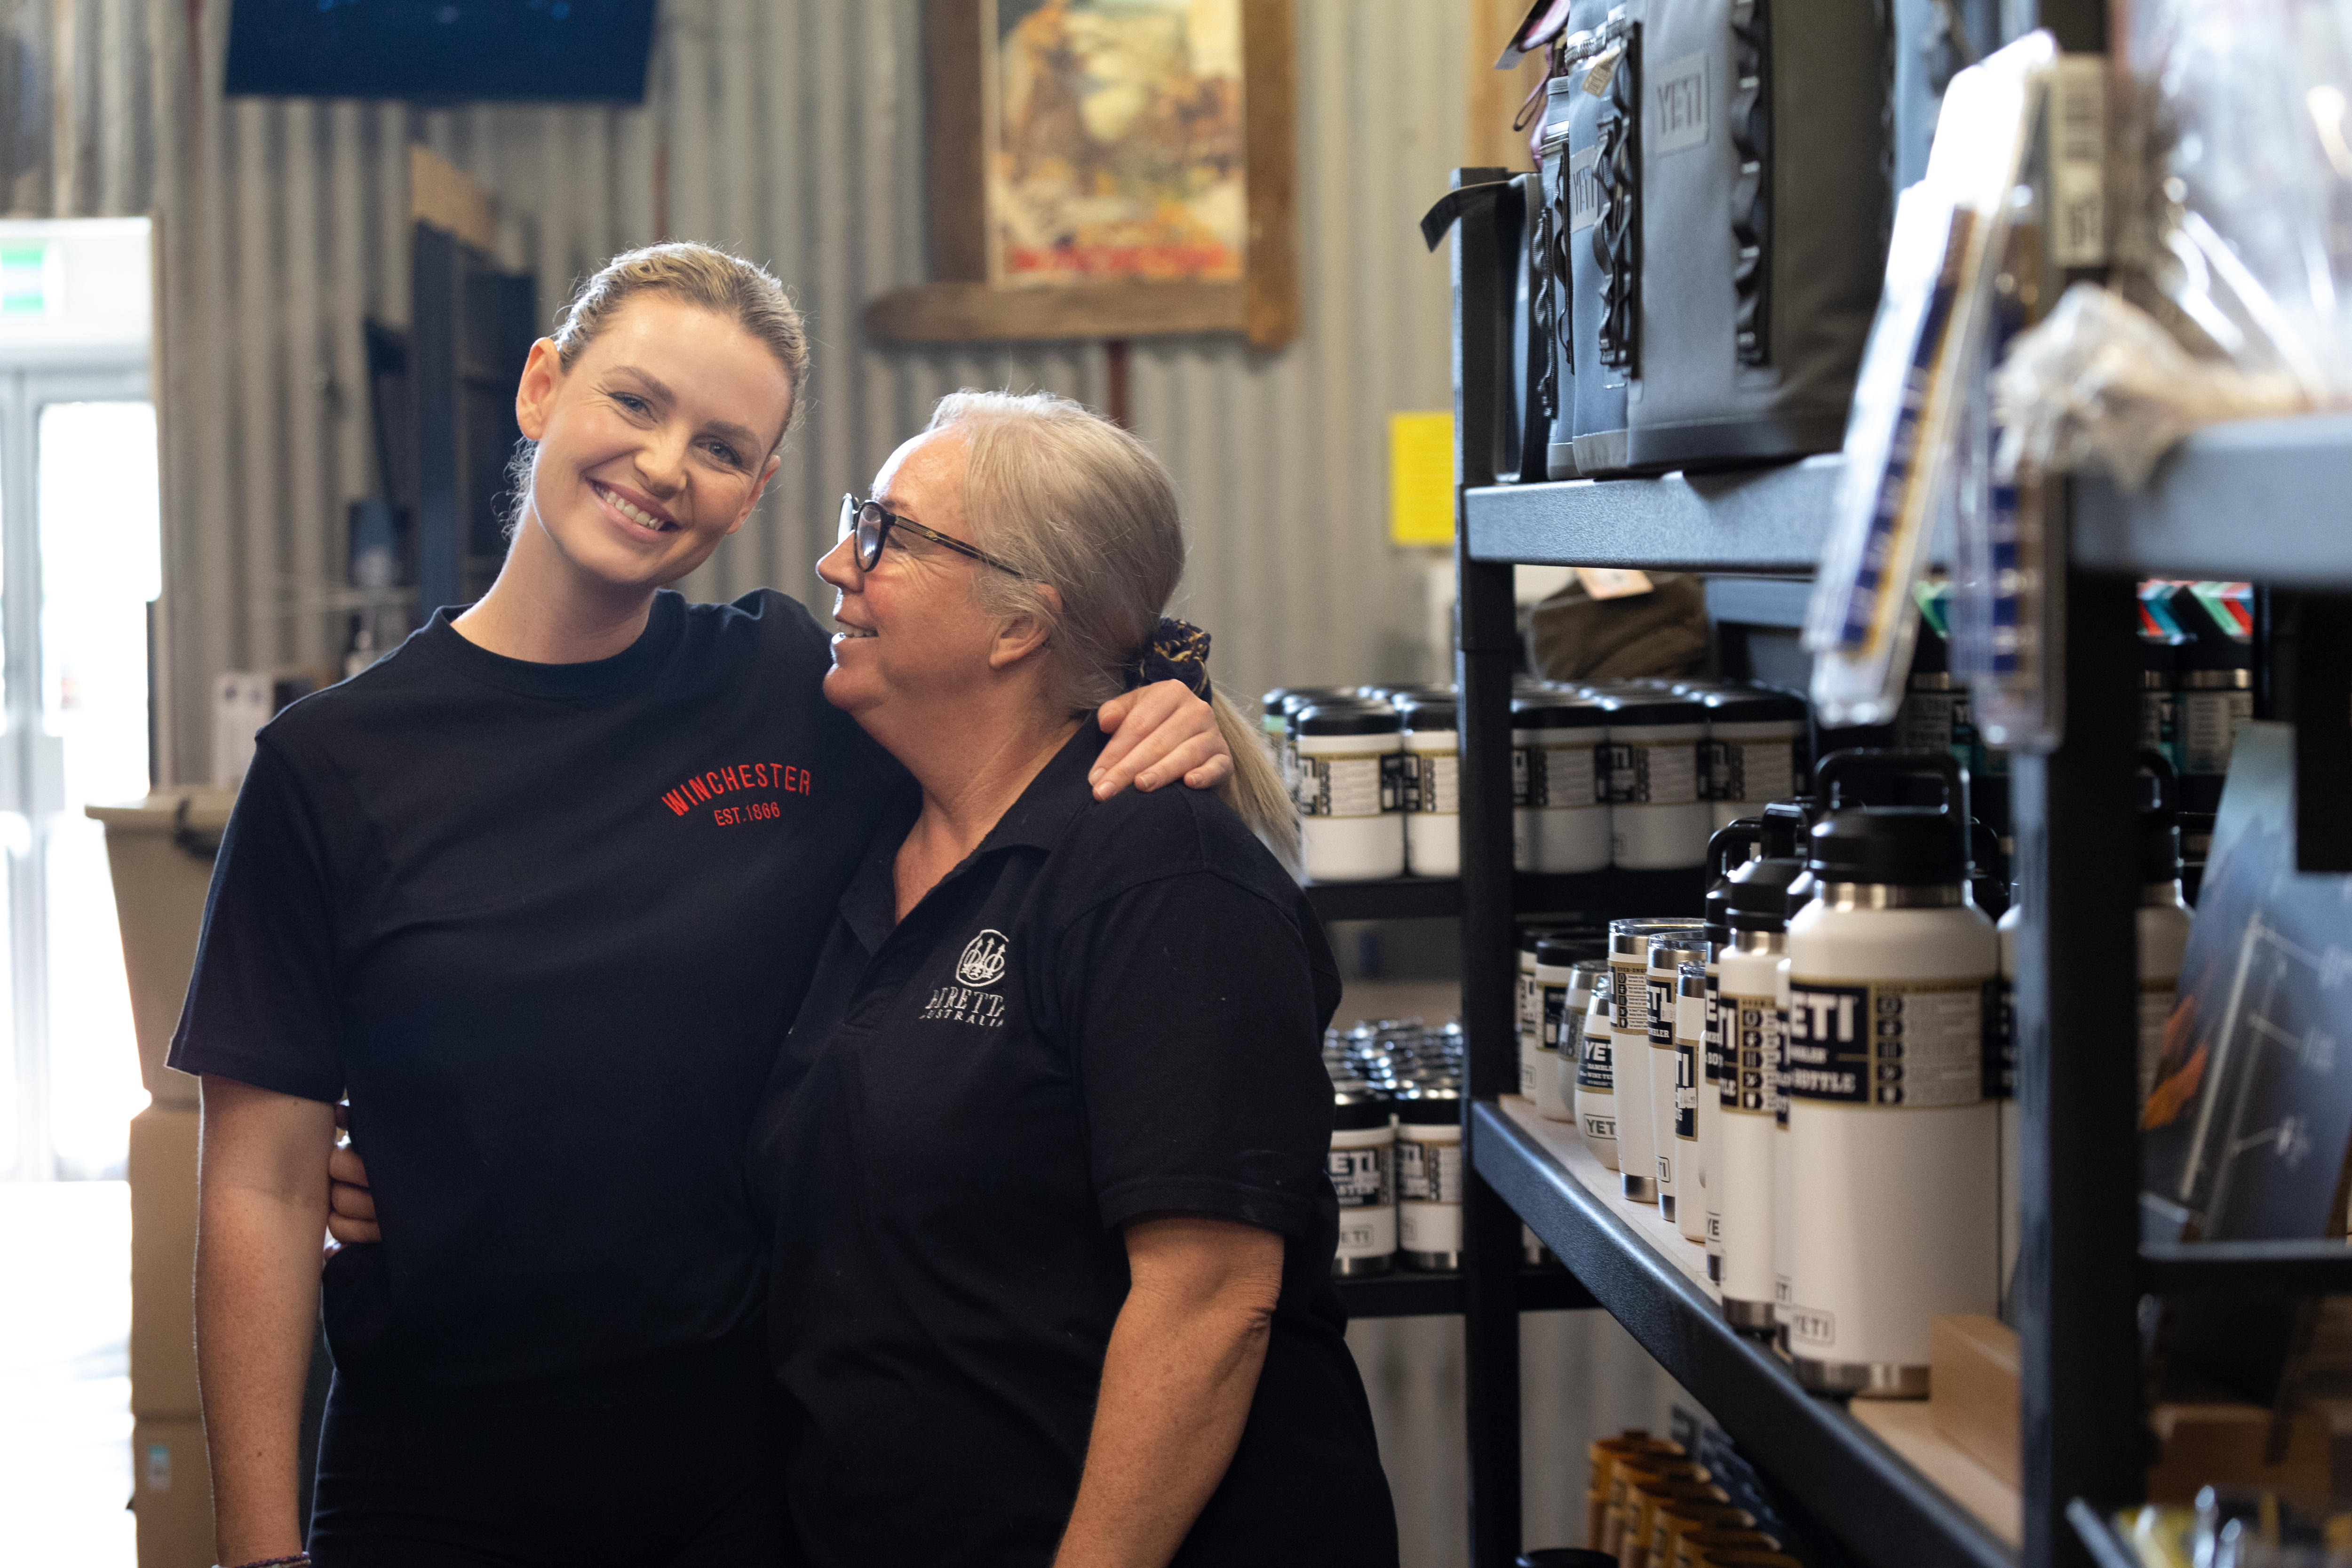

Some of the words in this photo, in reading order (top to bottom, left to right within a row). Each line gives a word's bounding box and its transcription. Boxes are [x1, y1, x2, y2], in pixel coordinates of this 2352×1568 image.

[1656, 73, 1701, 134] YETI
[661, 763, 811, 816] WINCHESTER
[714, 801, 781, 826] EST.1866
